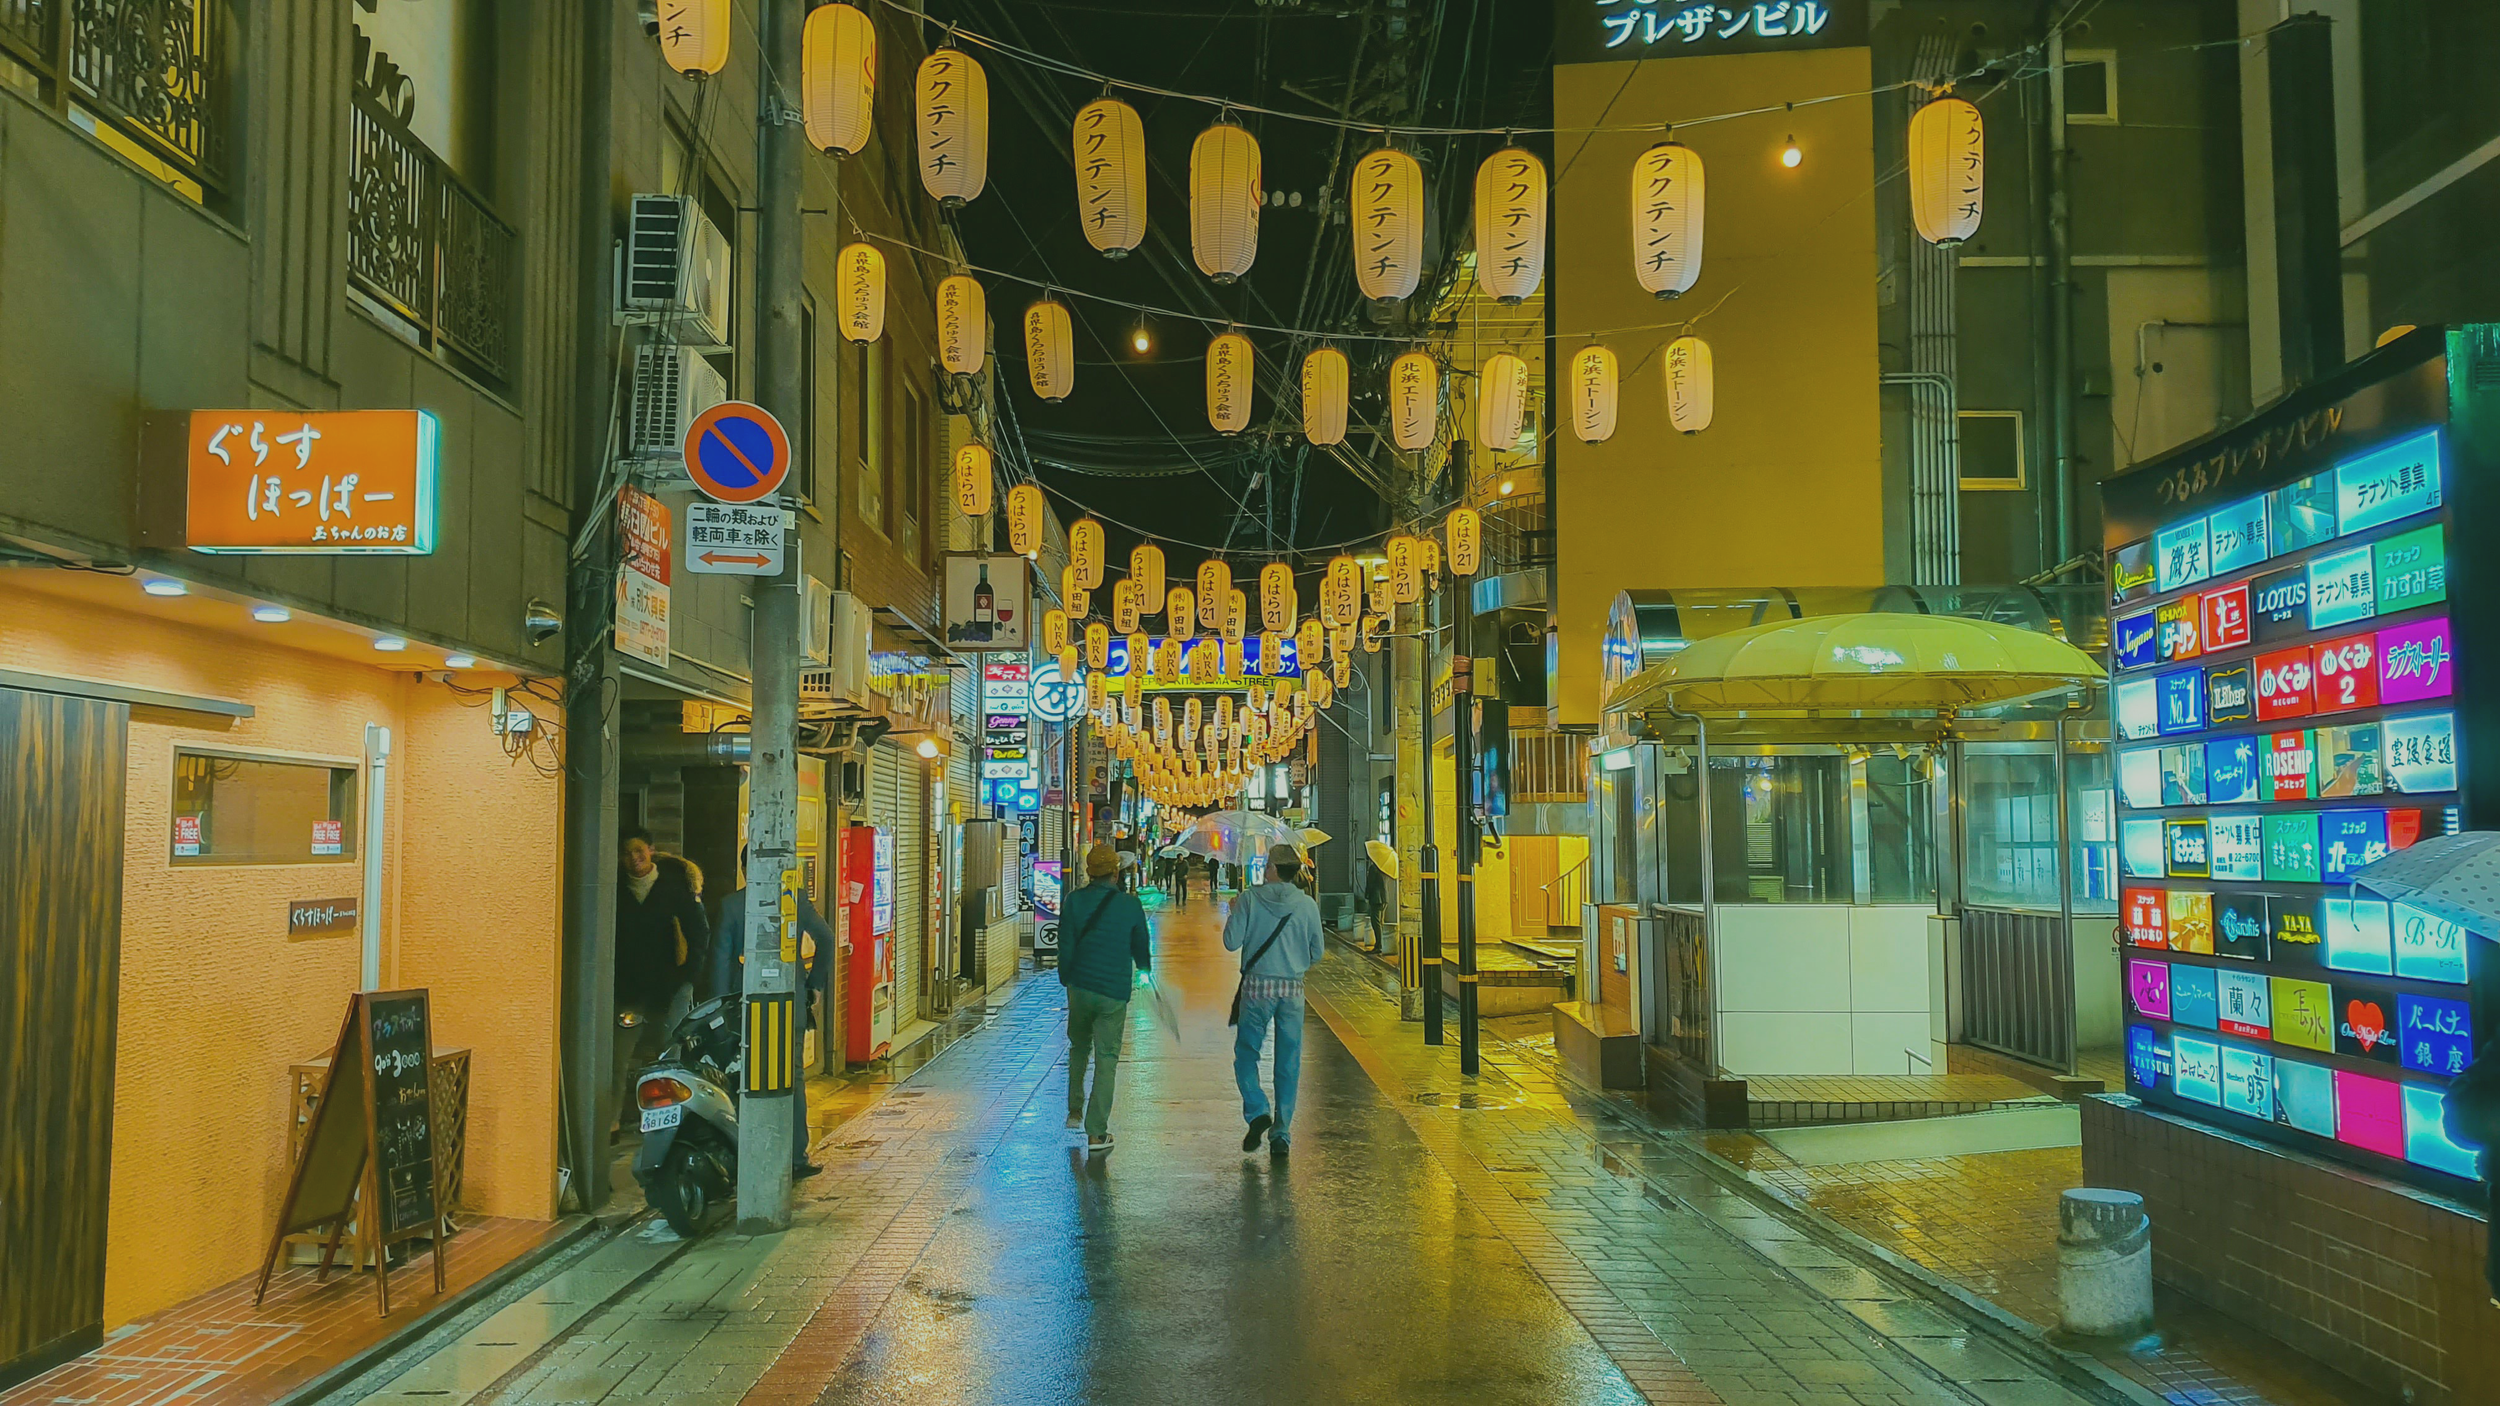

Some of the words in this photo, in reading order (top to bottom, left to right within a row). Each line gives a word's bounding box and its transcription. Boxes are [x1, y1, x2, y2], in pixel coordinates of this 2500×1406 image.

[1601, 2, 1829, 48] プレザンビル
[926, 54, 956, 176] ラクテンチ
[1083, 107, 1118, 229] ラクテンチ
[1959, 105, 1984, 221] ラクテンチ
[1368, 156, 1398, 279] ラクテンチ
[1504, 157, 1531, 277] ラクテンチ
[1646, 153, 1675, 274] ラクテンチ
[1401, 362, 1421, 439] 北浜エトーシン
[1583, 354, 1603, 430] 北浜エトーシン
[207, 421, 323, 470] ぐらす
[247, 473, 395, 522] ほっぱー
[2358, 462, 2426, 508] テナント募集
[311, 524, 408, 542] 玉ちゃんのお店
[692, 506, 779, 527] 二輪の類および
[692, 526, 778, 546] 軽両車を除く
[2215, 518, 2265, 556] テナント募集
[2169, 541, 2202, 585] 微笑
[2384, 545, 2421, 569] スナック
[2257, 582, 2307, 614] LOTUS
[2317, 570, 2371, 607] テナント募集
[2260, 663, 2312, 697] めぐみ
[2321, 643, 2371, 677] めぐみ
[2386, 636, 2450, 686] ラブストーリー
[2340, 676, 2356, 705] 2
[2265, 750, 2314, 777] ROSEHIP
[181, 827, 198, 840] FREE
[2276, 820, 2307, 834] スナック
[2283, 914, 2312, 933] YA-YA
